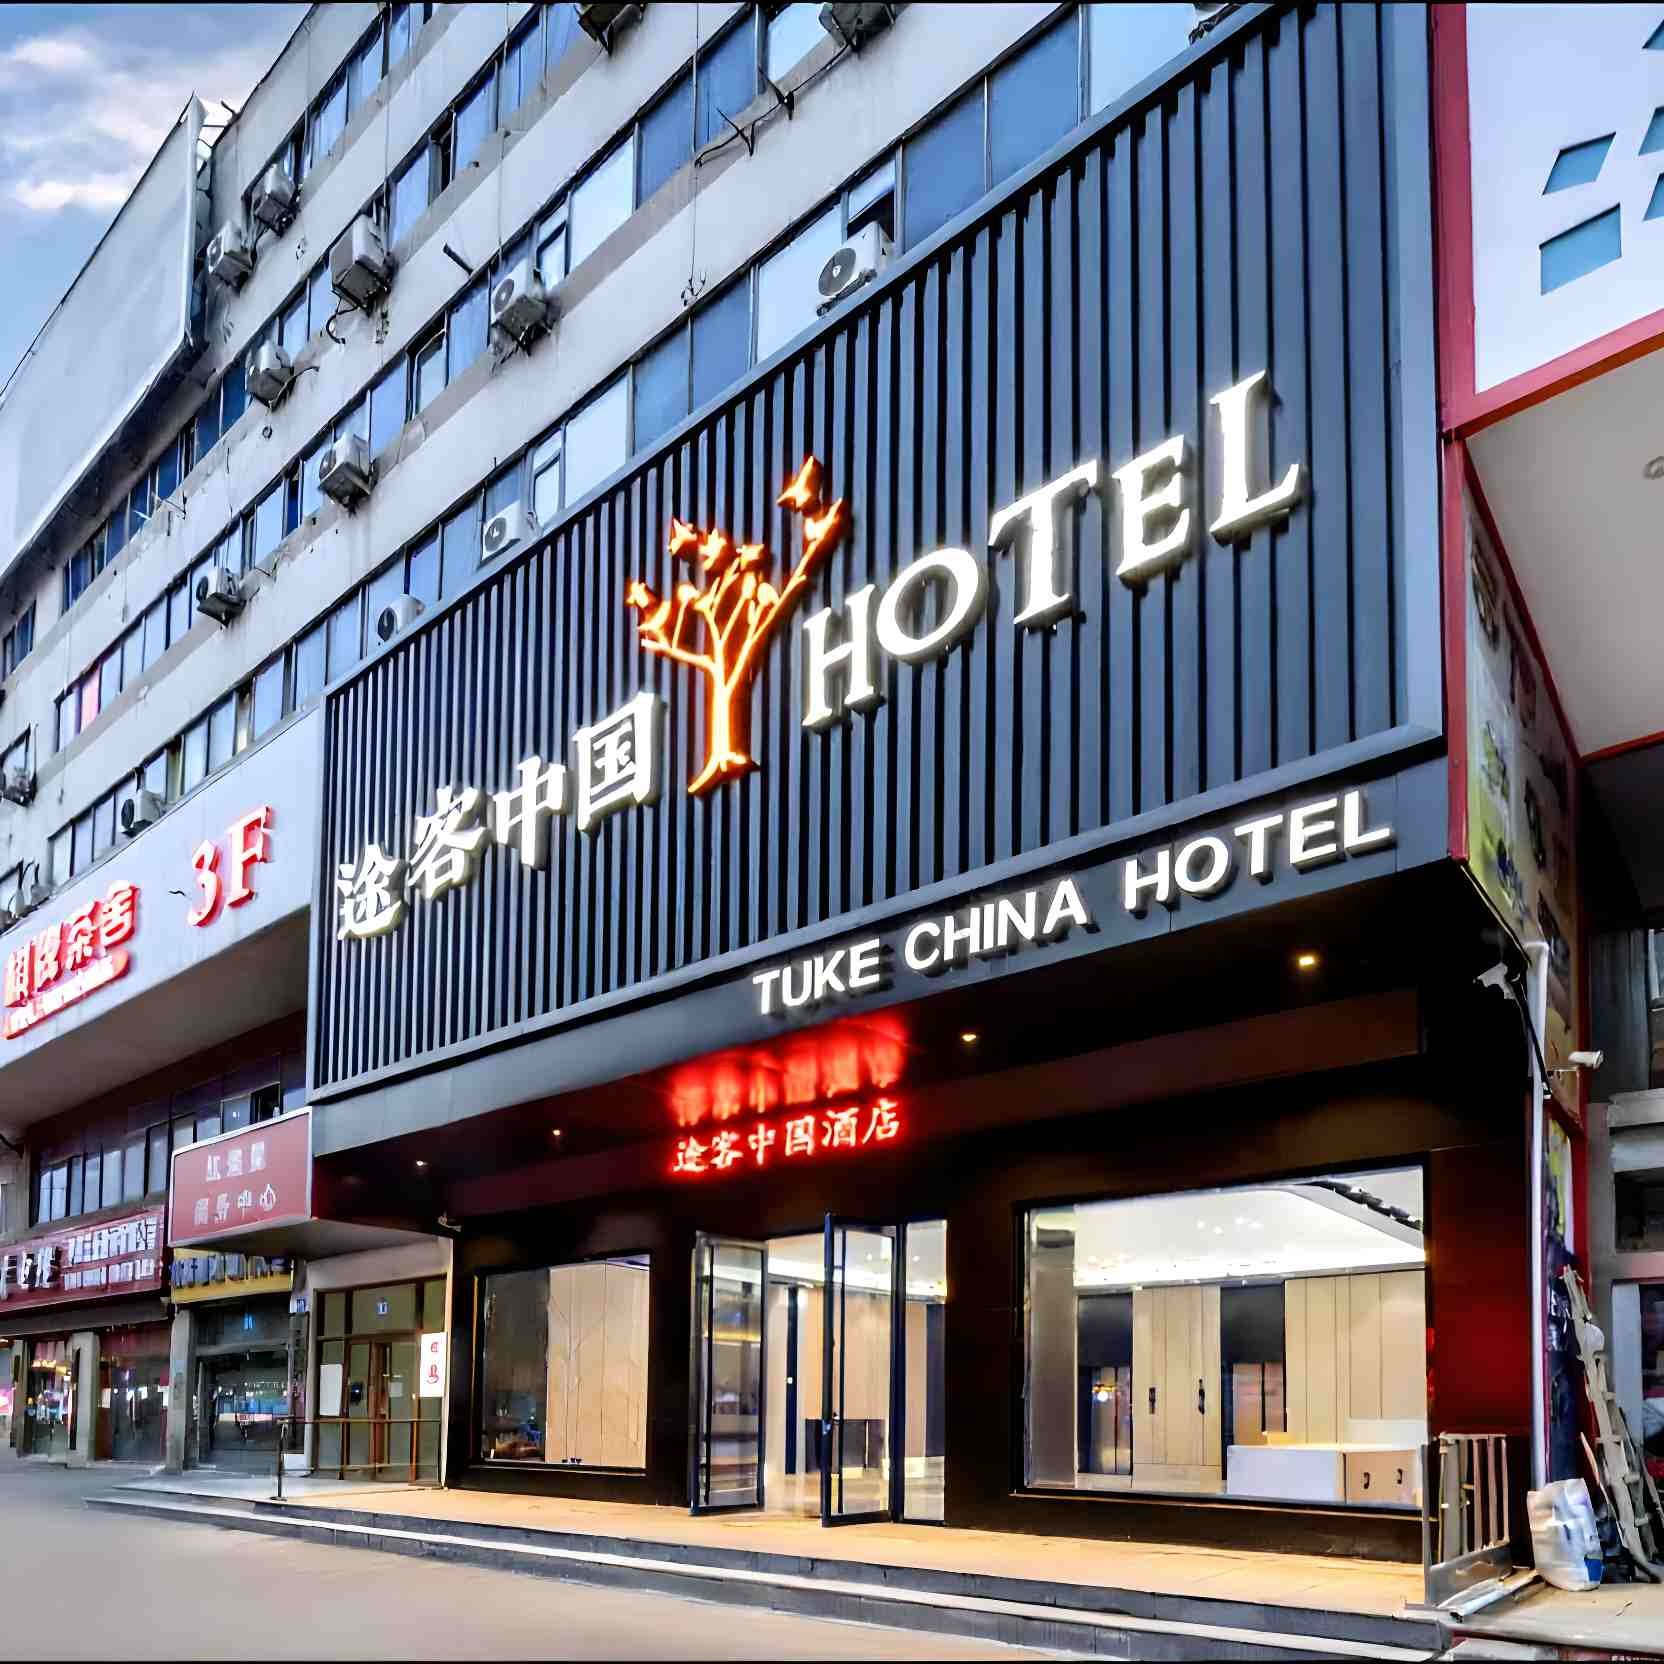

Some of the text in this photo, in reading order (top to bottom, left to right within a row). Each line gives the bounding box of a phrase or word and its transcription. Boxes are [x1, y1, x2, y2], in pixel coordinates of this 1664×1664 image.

[802, 368, 1301, 728] HOTEL
[187, 805, 273, 928] 3F
[336, 691, 664, 942] 途客中国
[752, 789, 1392, 1016] TUKE CHINA HOTEL
[671, 1097, 900, 1173] 途客中国酒店
